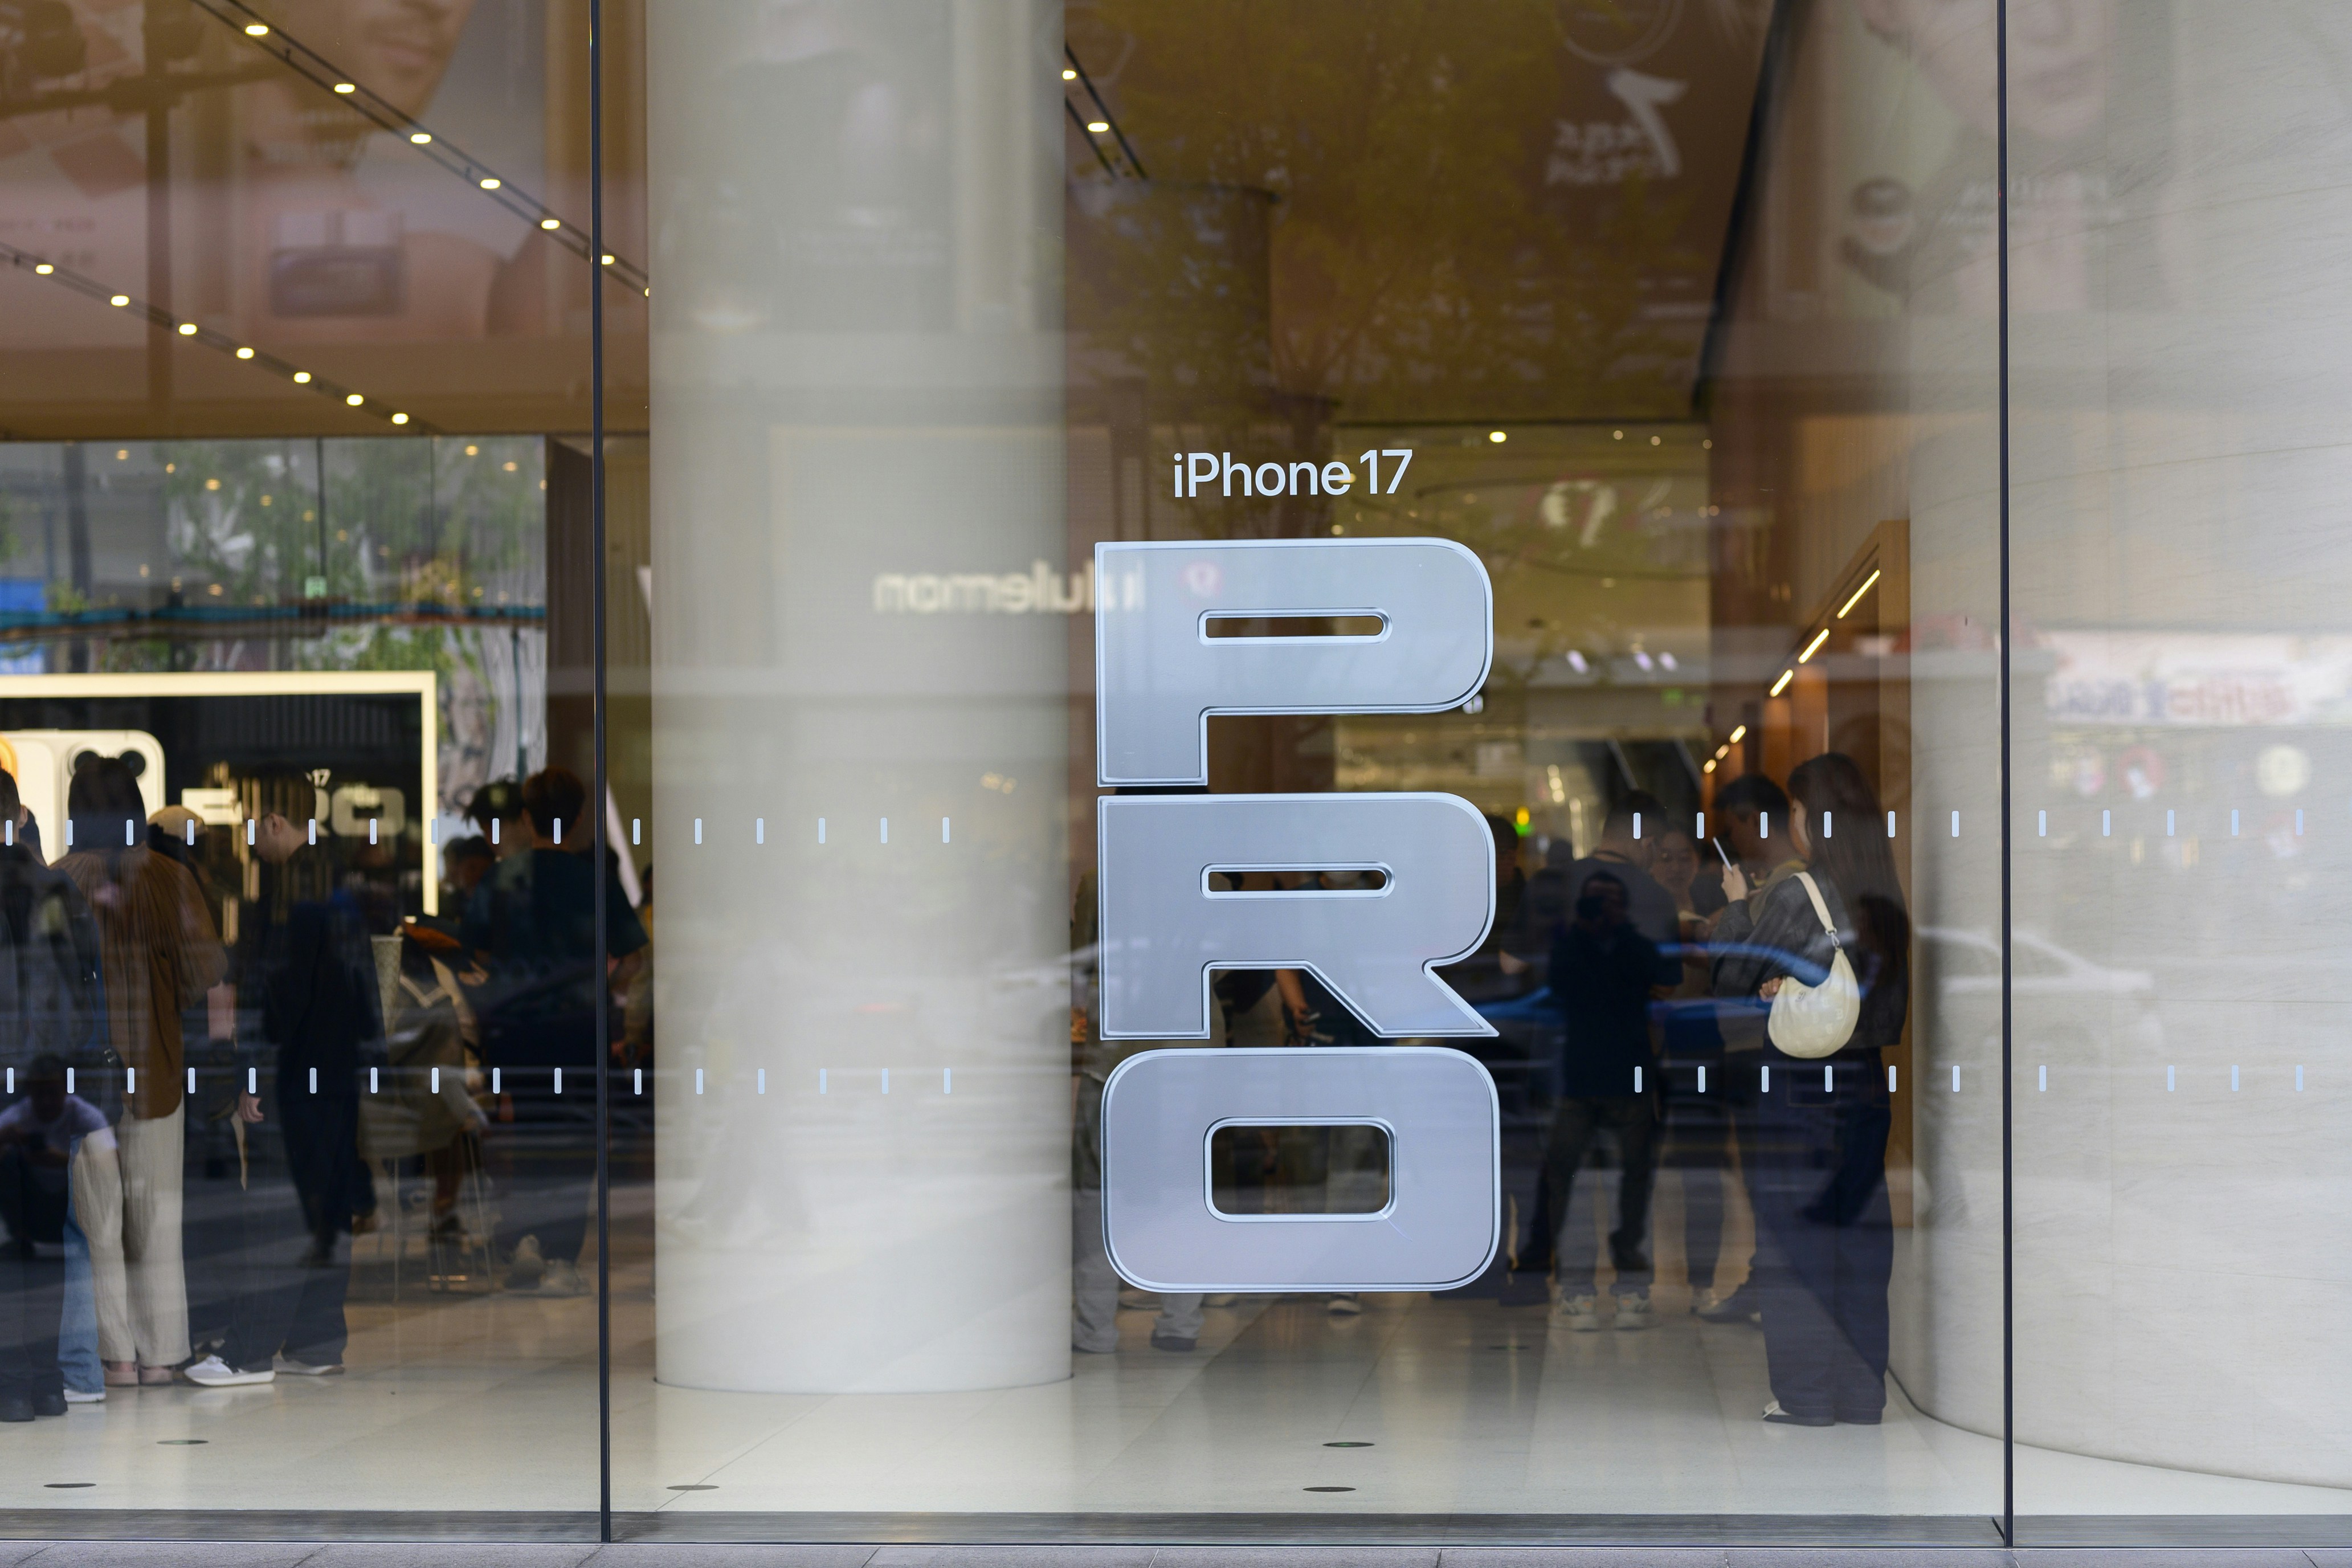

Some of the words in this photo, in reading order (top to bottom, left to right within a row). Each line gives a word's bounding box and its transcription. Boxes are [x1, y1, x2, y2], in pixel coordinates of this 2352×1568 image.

[1174, 452, 1351, 497] iPhone
[1360, 449, 1413, 495] 17
[312, 768, 330, 787] 17
[182, 787, 406, 837] PO
[1095, 537, 1500, 1292] PRO
